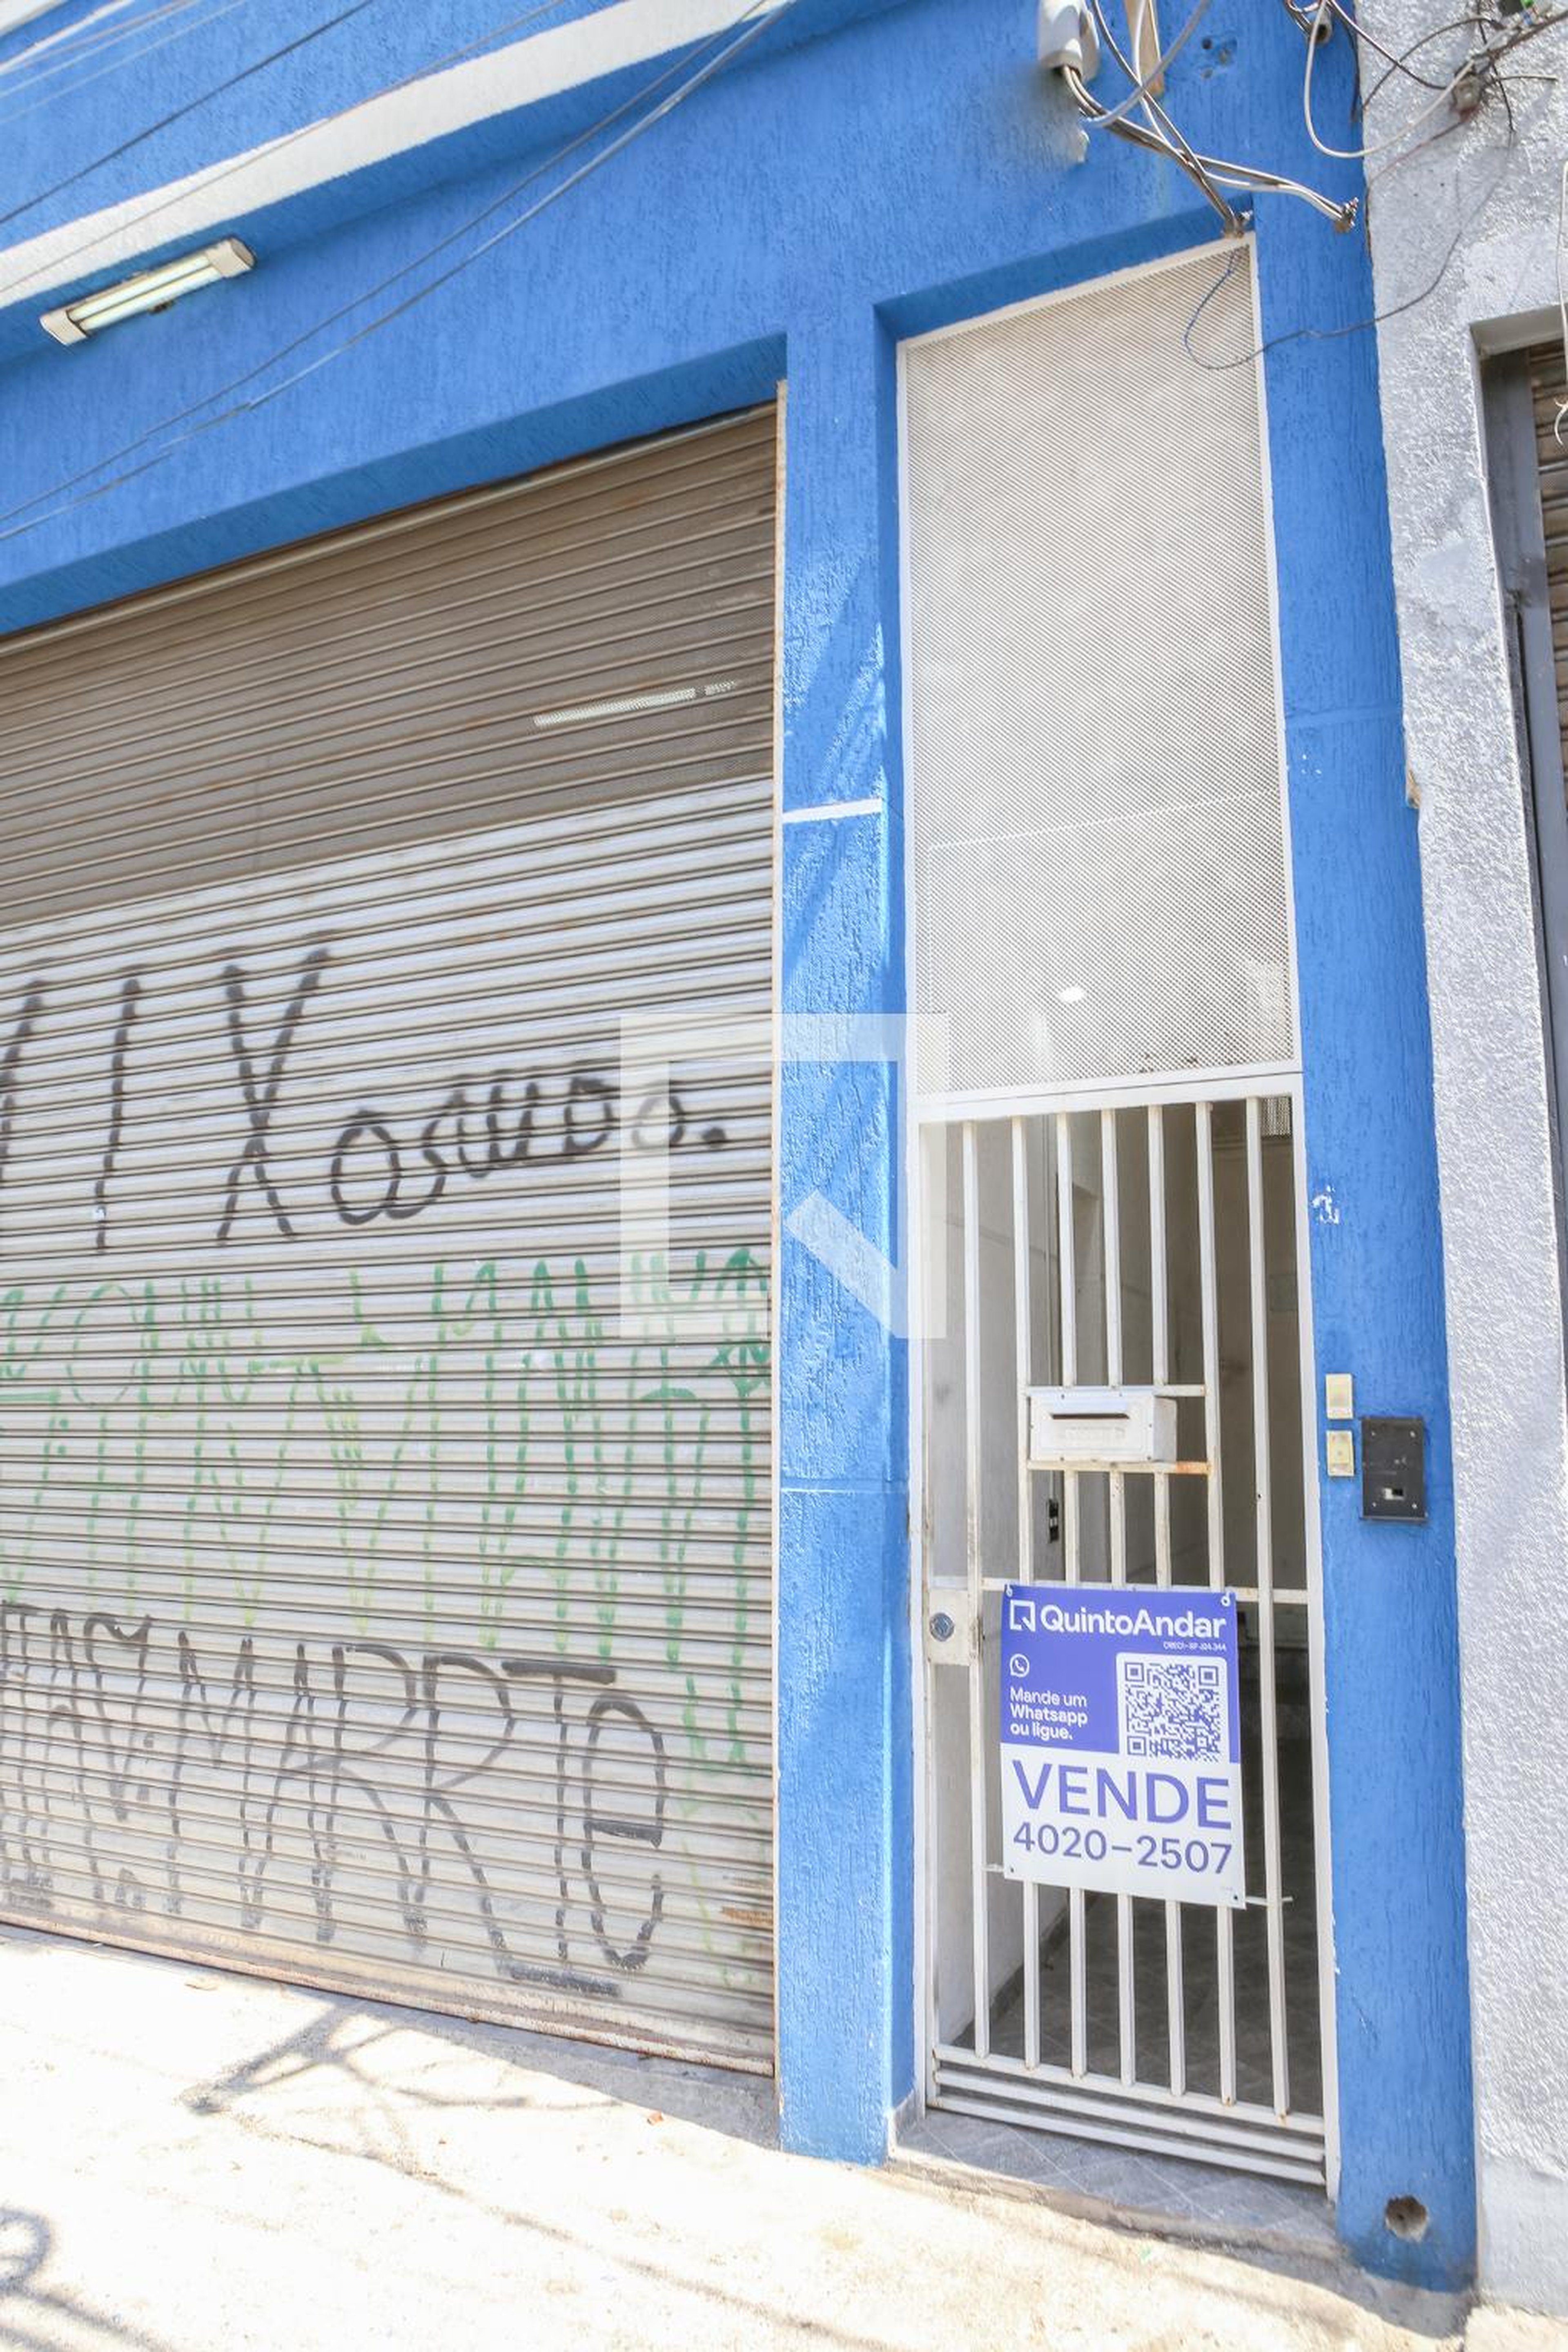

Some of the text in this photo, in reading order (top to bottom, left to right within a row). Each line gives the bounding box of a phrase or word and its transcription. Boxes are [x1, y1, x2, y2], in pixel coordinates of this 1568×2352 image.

[1040, 1605, 1225, 1638] QuintoAndar
[1010, 1686, 1087, 1708] Mande um
[1010, 1702, 1088, 1728] Whatsapp
[1010, 1721, 1073, 1742] ou ligue.
[1012, 1760, 1232, 1830] VENDE
[1013, 1821, 1232, 1874] 4020-2507
